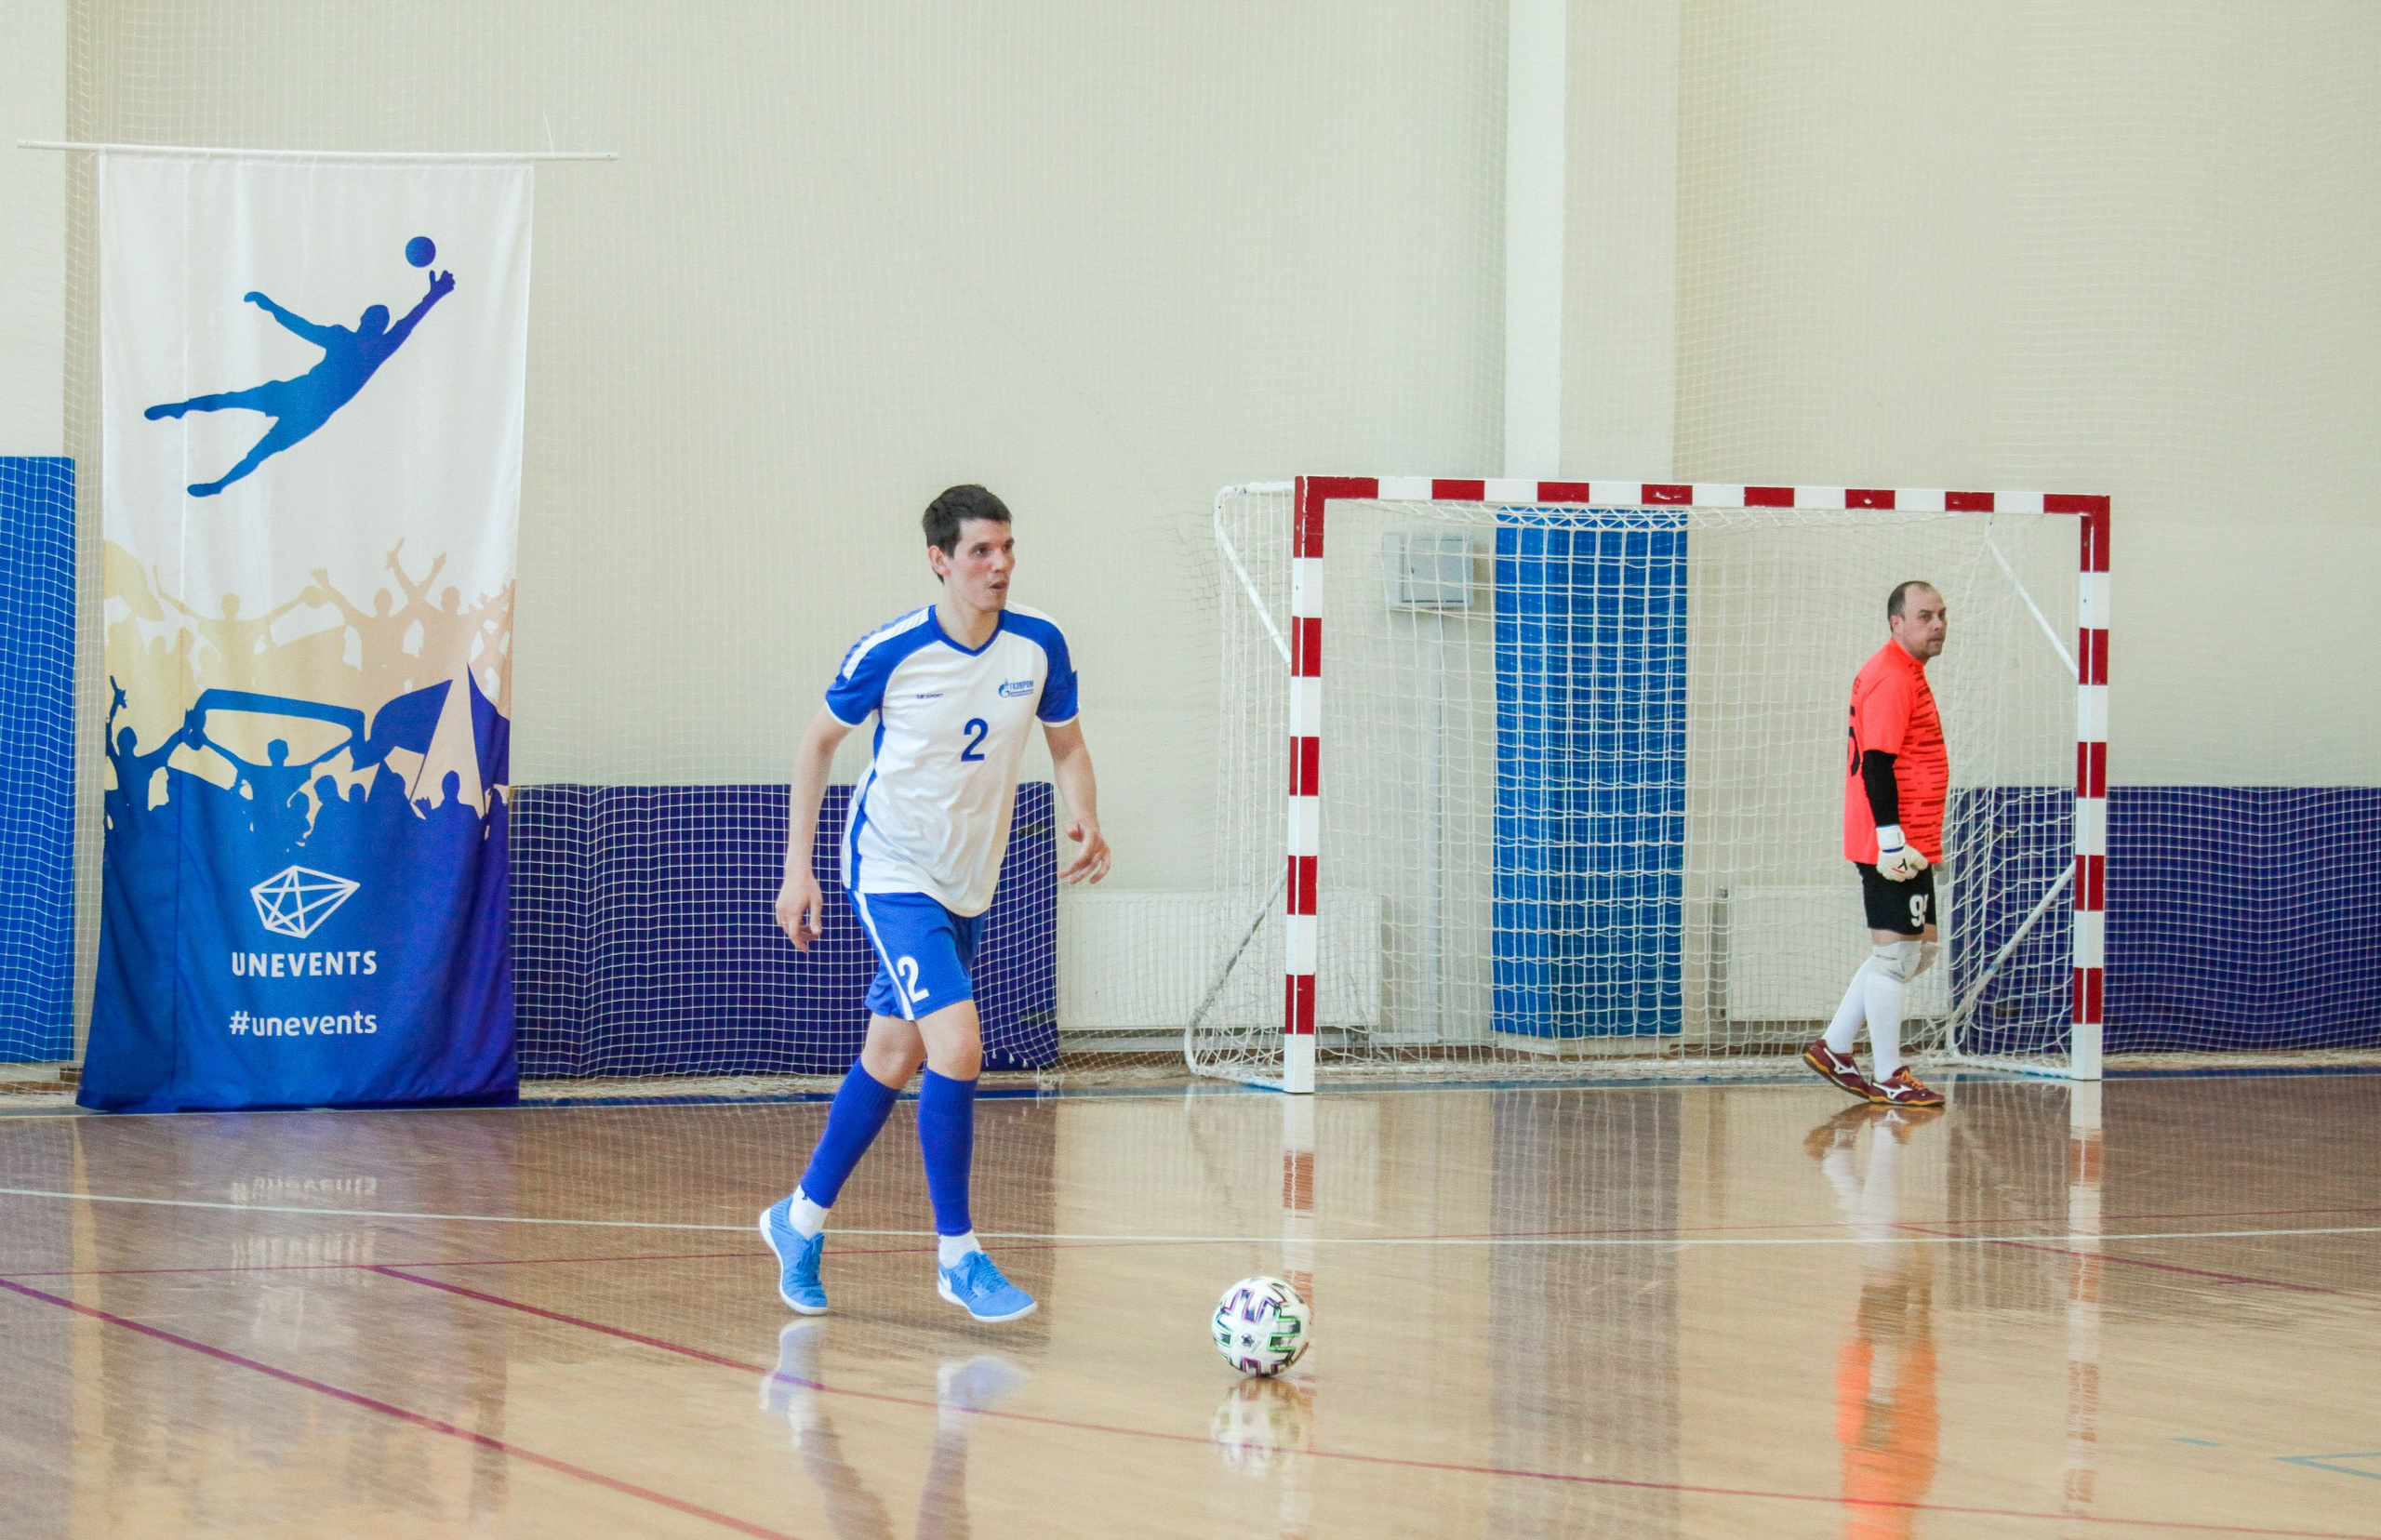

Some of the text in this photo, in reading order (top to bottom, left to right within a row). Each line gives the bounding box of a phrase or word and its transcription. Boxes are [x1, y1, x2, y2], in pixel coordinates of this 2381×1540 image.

[961, 718, 989, 762] 2
[232, 950, 377, 977] UNEVENTS
[898, 956, 929, 1002] 2
[229, 1010, 377, 1036] #unevents
